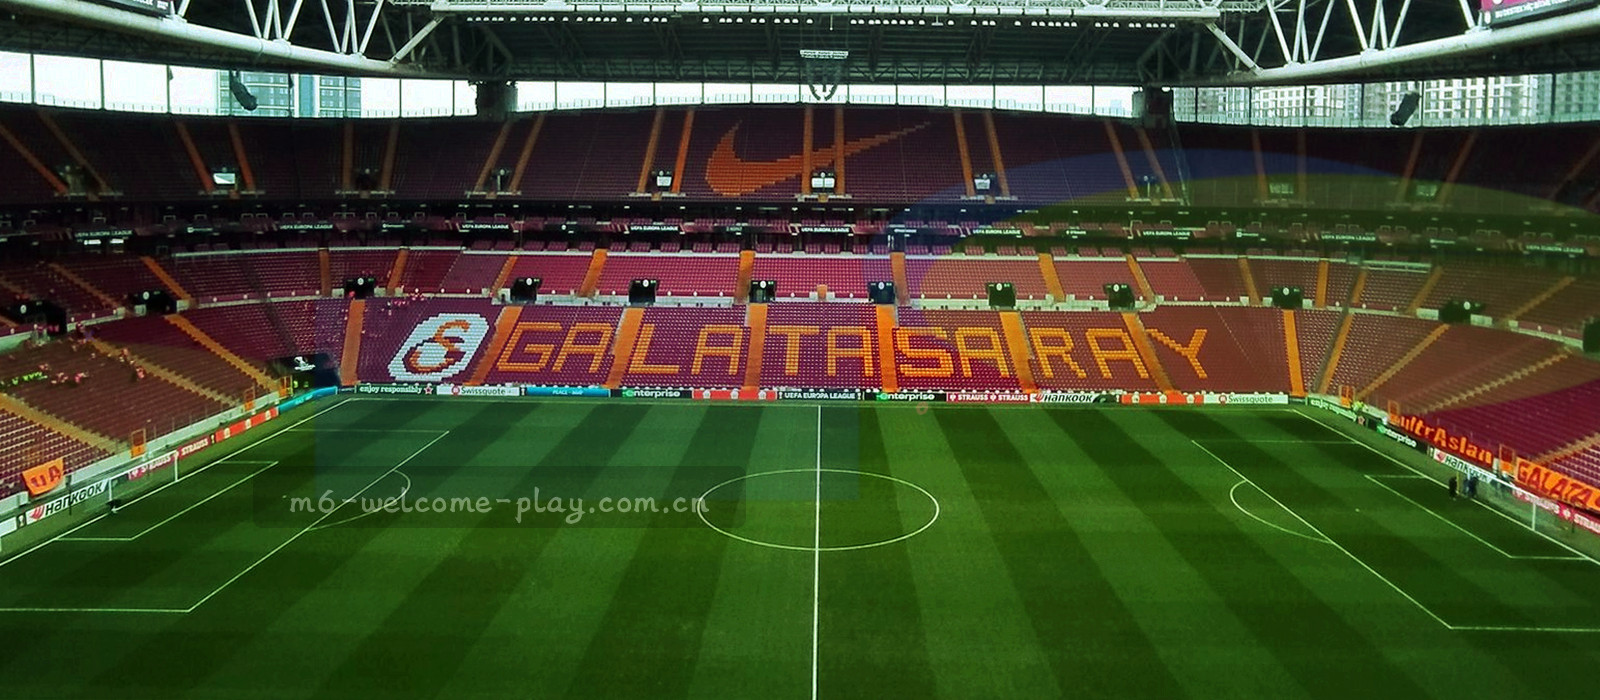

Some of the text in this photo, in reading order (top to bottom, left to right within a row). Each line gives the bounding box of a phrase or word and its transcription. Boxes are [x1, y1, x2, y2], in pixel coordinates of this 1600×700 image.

[497, 321, 1208, 379] GALATASARAY
[360, 384, 422, 394] enjoy responsibly
[461, 387, 506, 397] Swissquote
[622, 389, 681, 399] enterprise
[784, 391, 856, 399] UEFA EUROPA LEAGUE
[876, 392, 935, 401] enterprise
